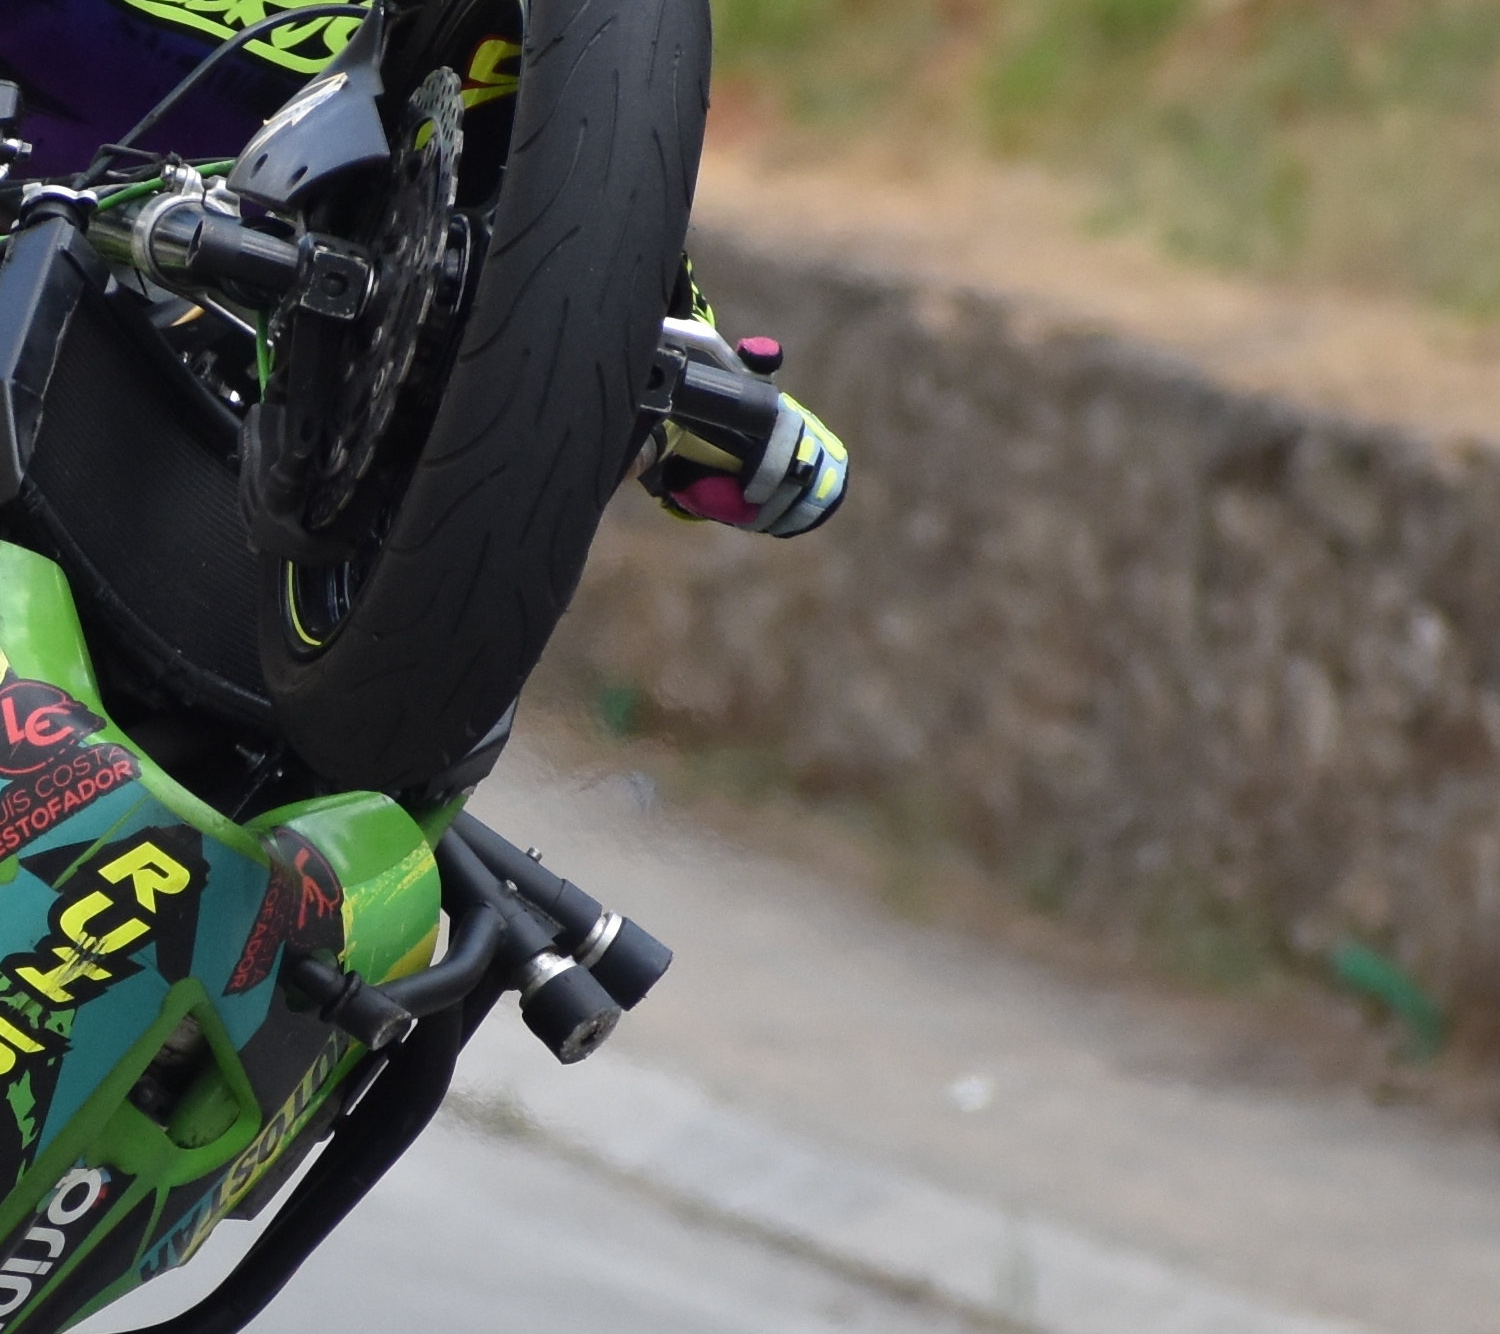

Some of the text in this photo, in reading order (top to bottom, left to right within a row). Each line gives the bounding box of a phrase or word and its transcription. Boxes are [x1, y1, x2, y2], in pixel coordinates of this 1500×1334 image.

[35, 746, 126, 798] COSTA
[15, 841, 191, 1003] RUI
[230, 873, 284, 989] TOFADOR
